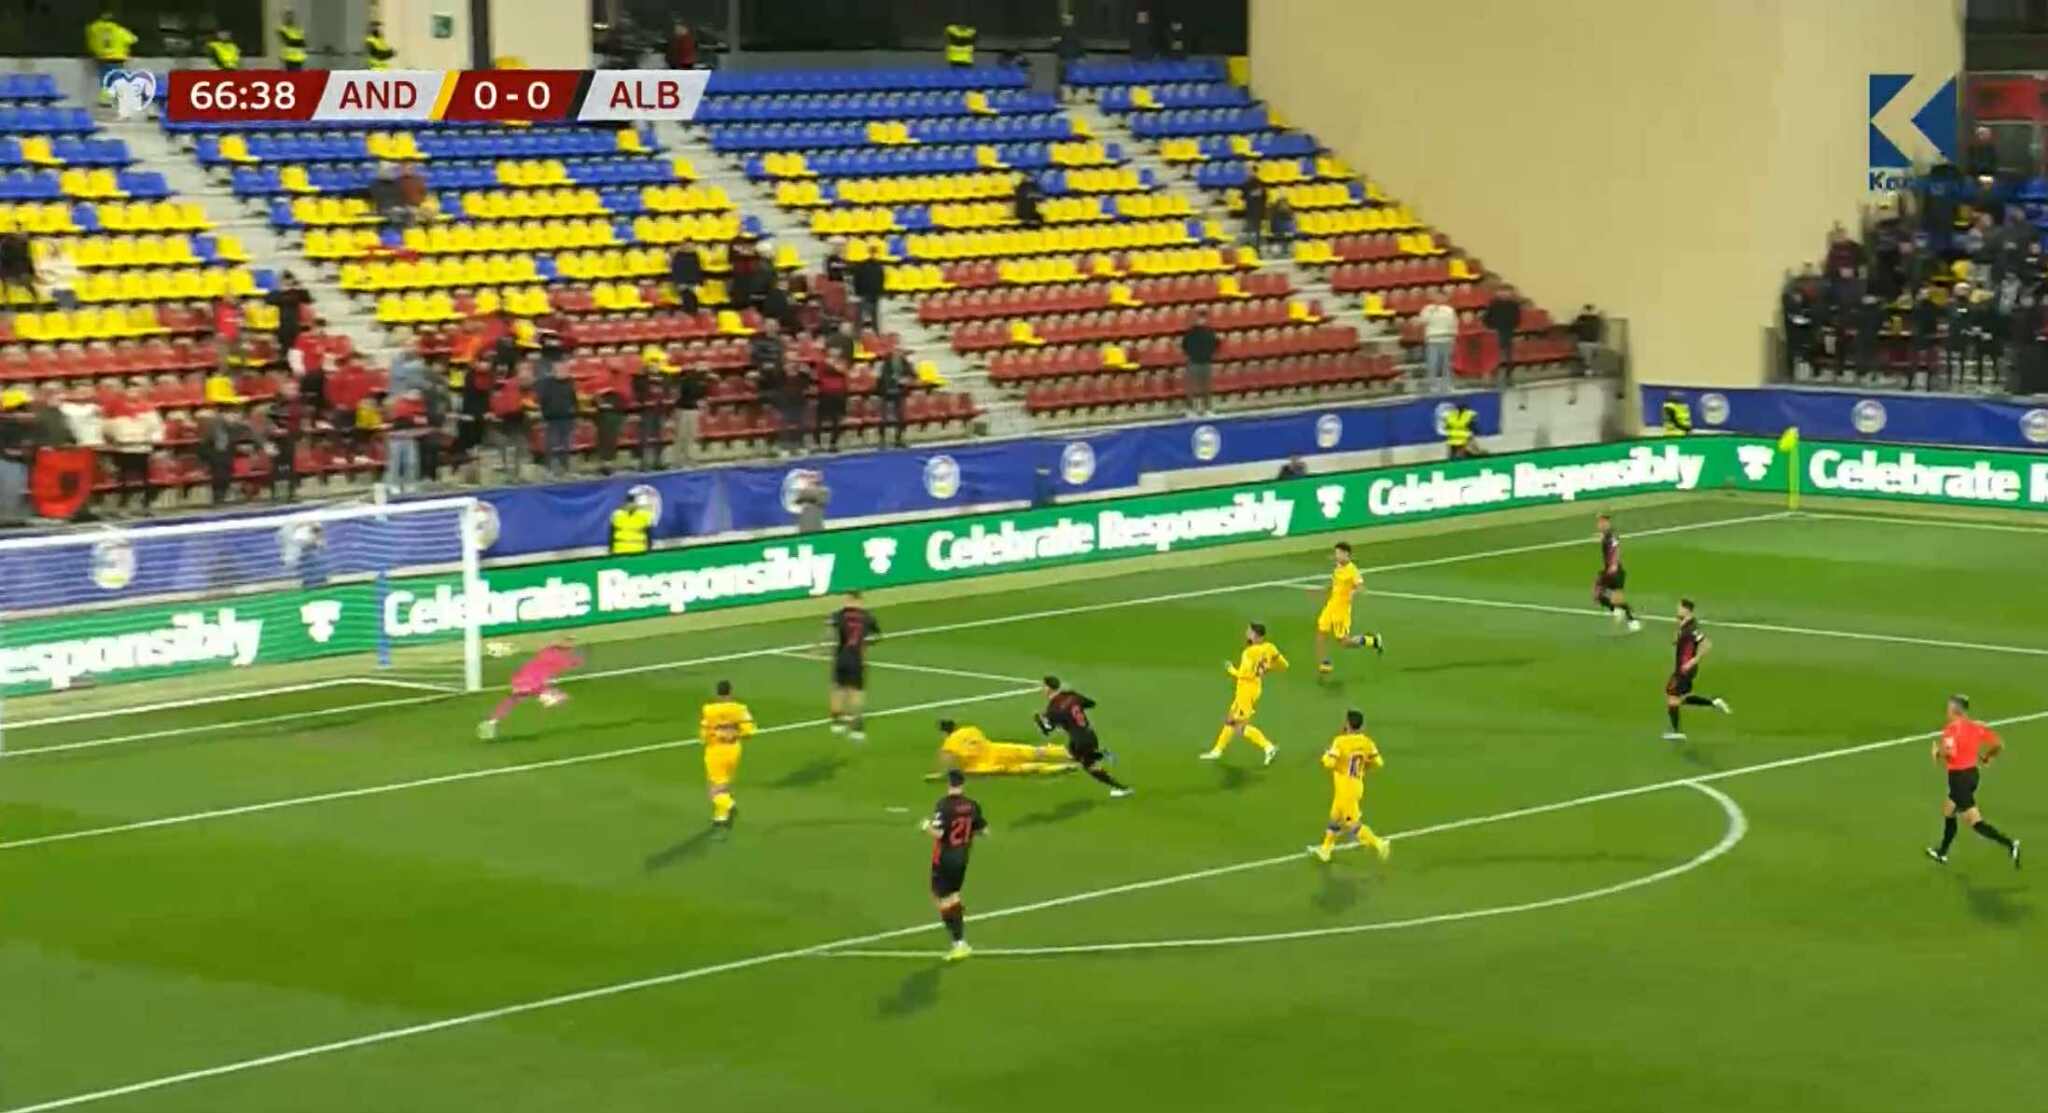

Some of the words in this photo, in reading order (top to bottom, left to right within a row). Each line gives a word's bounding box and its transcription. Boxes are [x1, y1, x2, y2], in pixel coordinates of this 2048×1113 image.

[1368, 468, 1512, 515] Celebrate
[1513, 444, 1705, 501] Responsibly
[1809, 447, 2021, 501] Celebrate
[926, 517, 1095, 571] Celebrate
[1098, 489, 1295, 551] Responsibly
[597, 543, 836, 613] Responsibly
[0, 607, 264, 690] esponsibly
